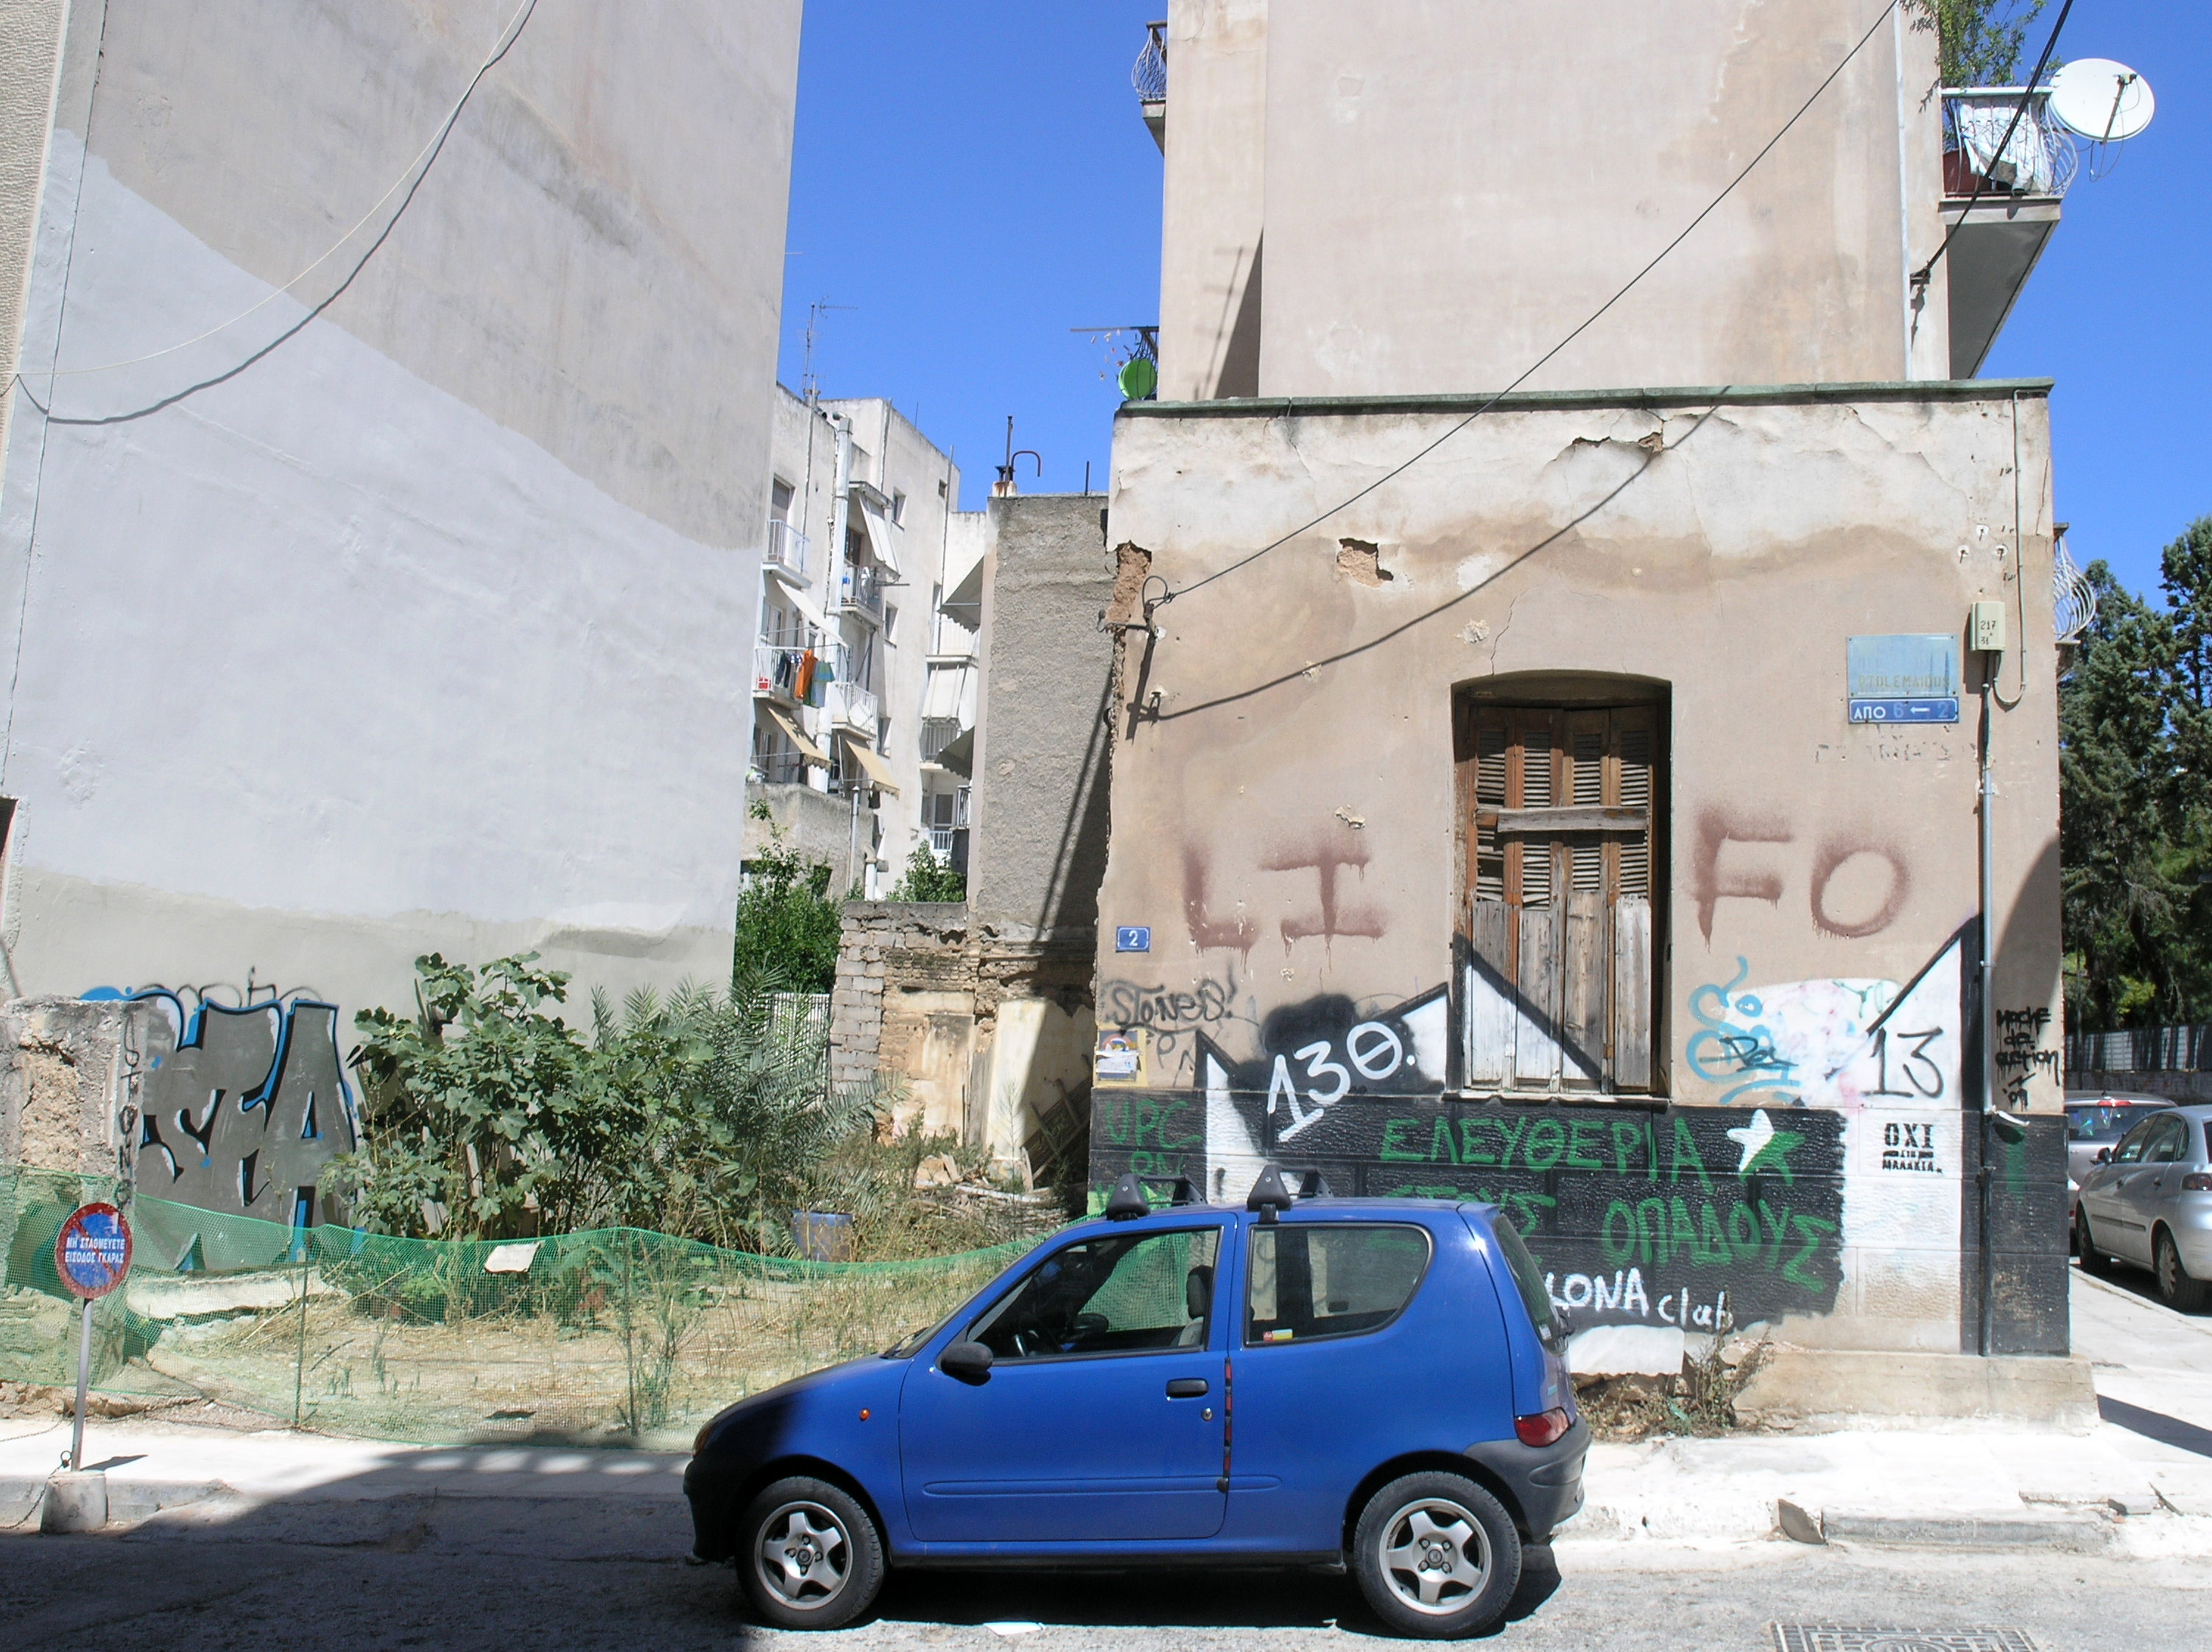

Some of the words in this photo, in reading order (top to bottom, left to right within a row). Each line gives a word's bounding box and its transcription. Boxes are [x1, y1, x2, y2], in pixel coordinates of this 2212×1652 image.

[1853, 706, 1886, 719] ΑΠΟ
[1893, 702, 1904, 719] 6
[1937, 702, 1949, 719] 2
[1128, 931, 1139, 947] 2
[1859, 1026, 1945, 1098] 13
[1884, 1123, 1934, 1148] ΟΧΙ
[1379, 1116, 1714, 1196] ΕΛΕΥΘΕΡΙΑ
[66, 1237, 77, 1249] ΜΗ
[80, 1237, 126, 1249] ΣΤΑΘΜΕΥΕΤΕ
[1601, 1195, 1837, 1294] ΟΠΑΔΟΥΣ
[65, 1252, 96, 1263] ΕΙΣΟΔΟΣ
[98, 1252, 124, 1263] ΓΚΑΡΑΖ
